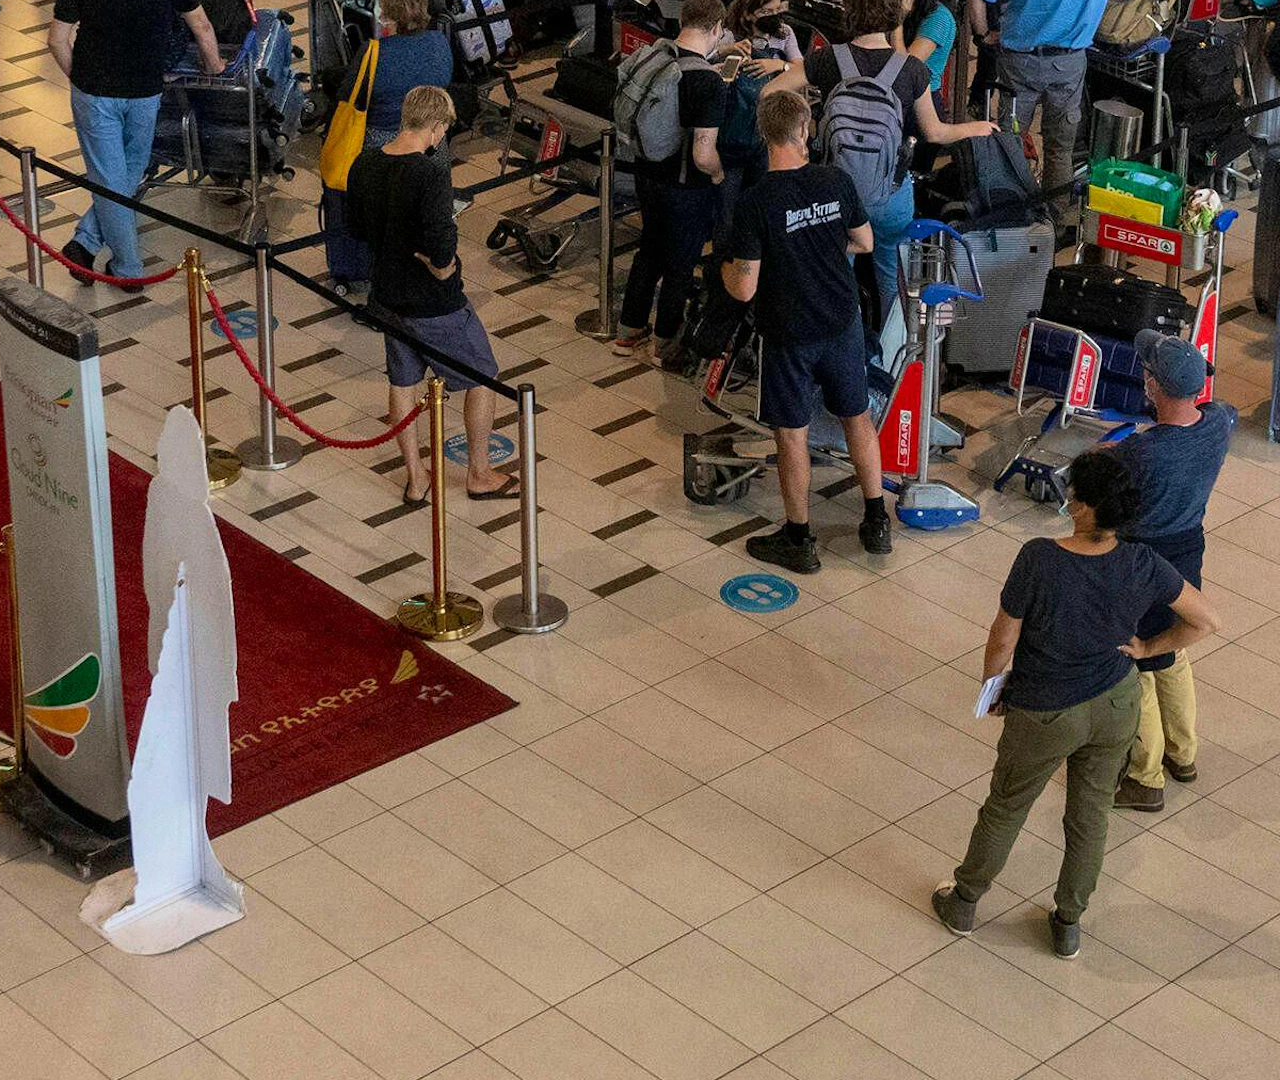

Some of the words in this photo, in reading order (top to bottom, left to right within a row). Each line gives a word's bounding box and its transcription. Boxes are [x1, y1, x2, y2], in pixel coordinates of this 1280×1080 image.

[1117, 230, 1158, 249] SPAR
[1077, 364, 1088, 393] SPAR
[900, 423, 910, 456] SPAR
[10, 448, 45, 488] Cloud
[45, 479, 79, 509] Nine
